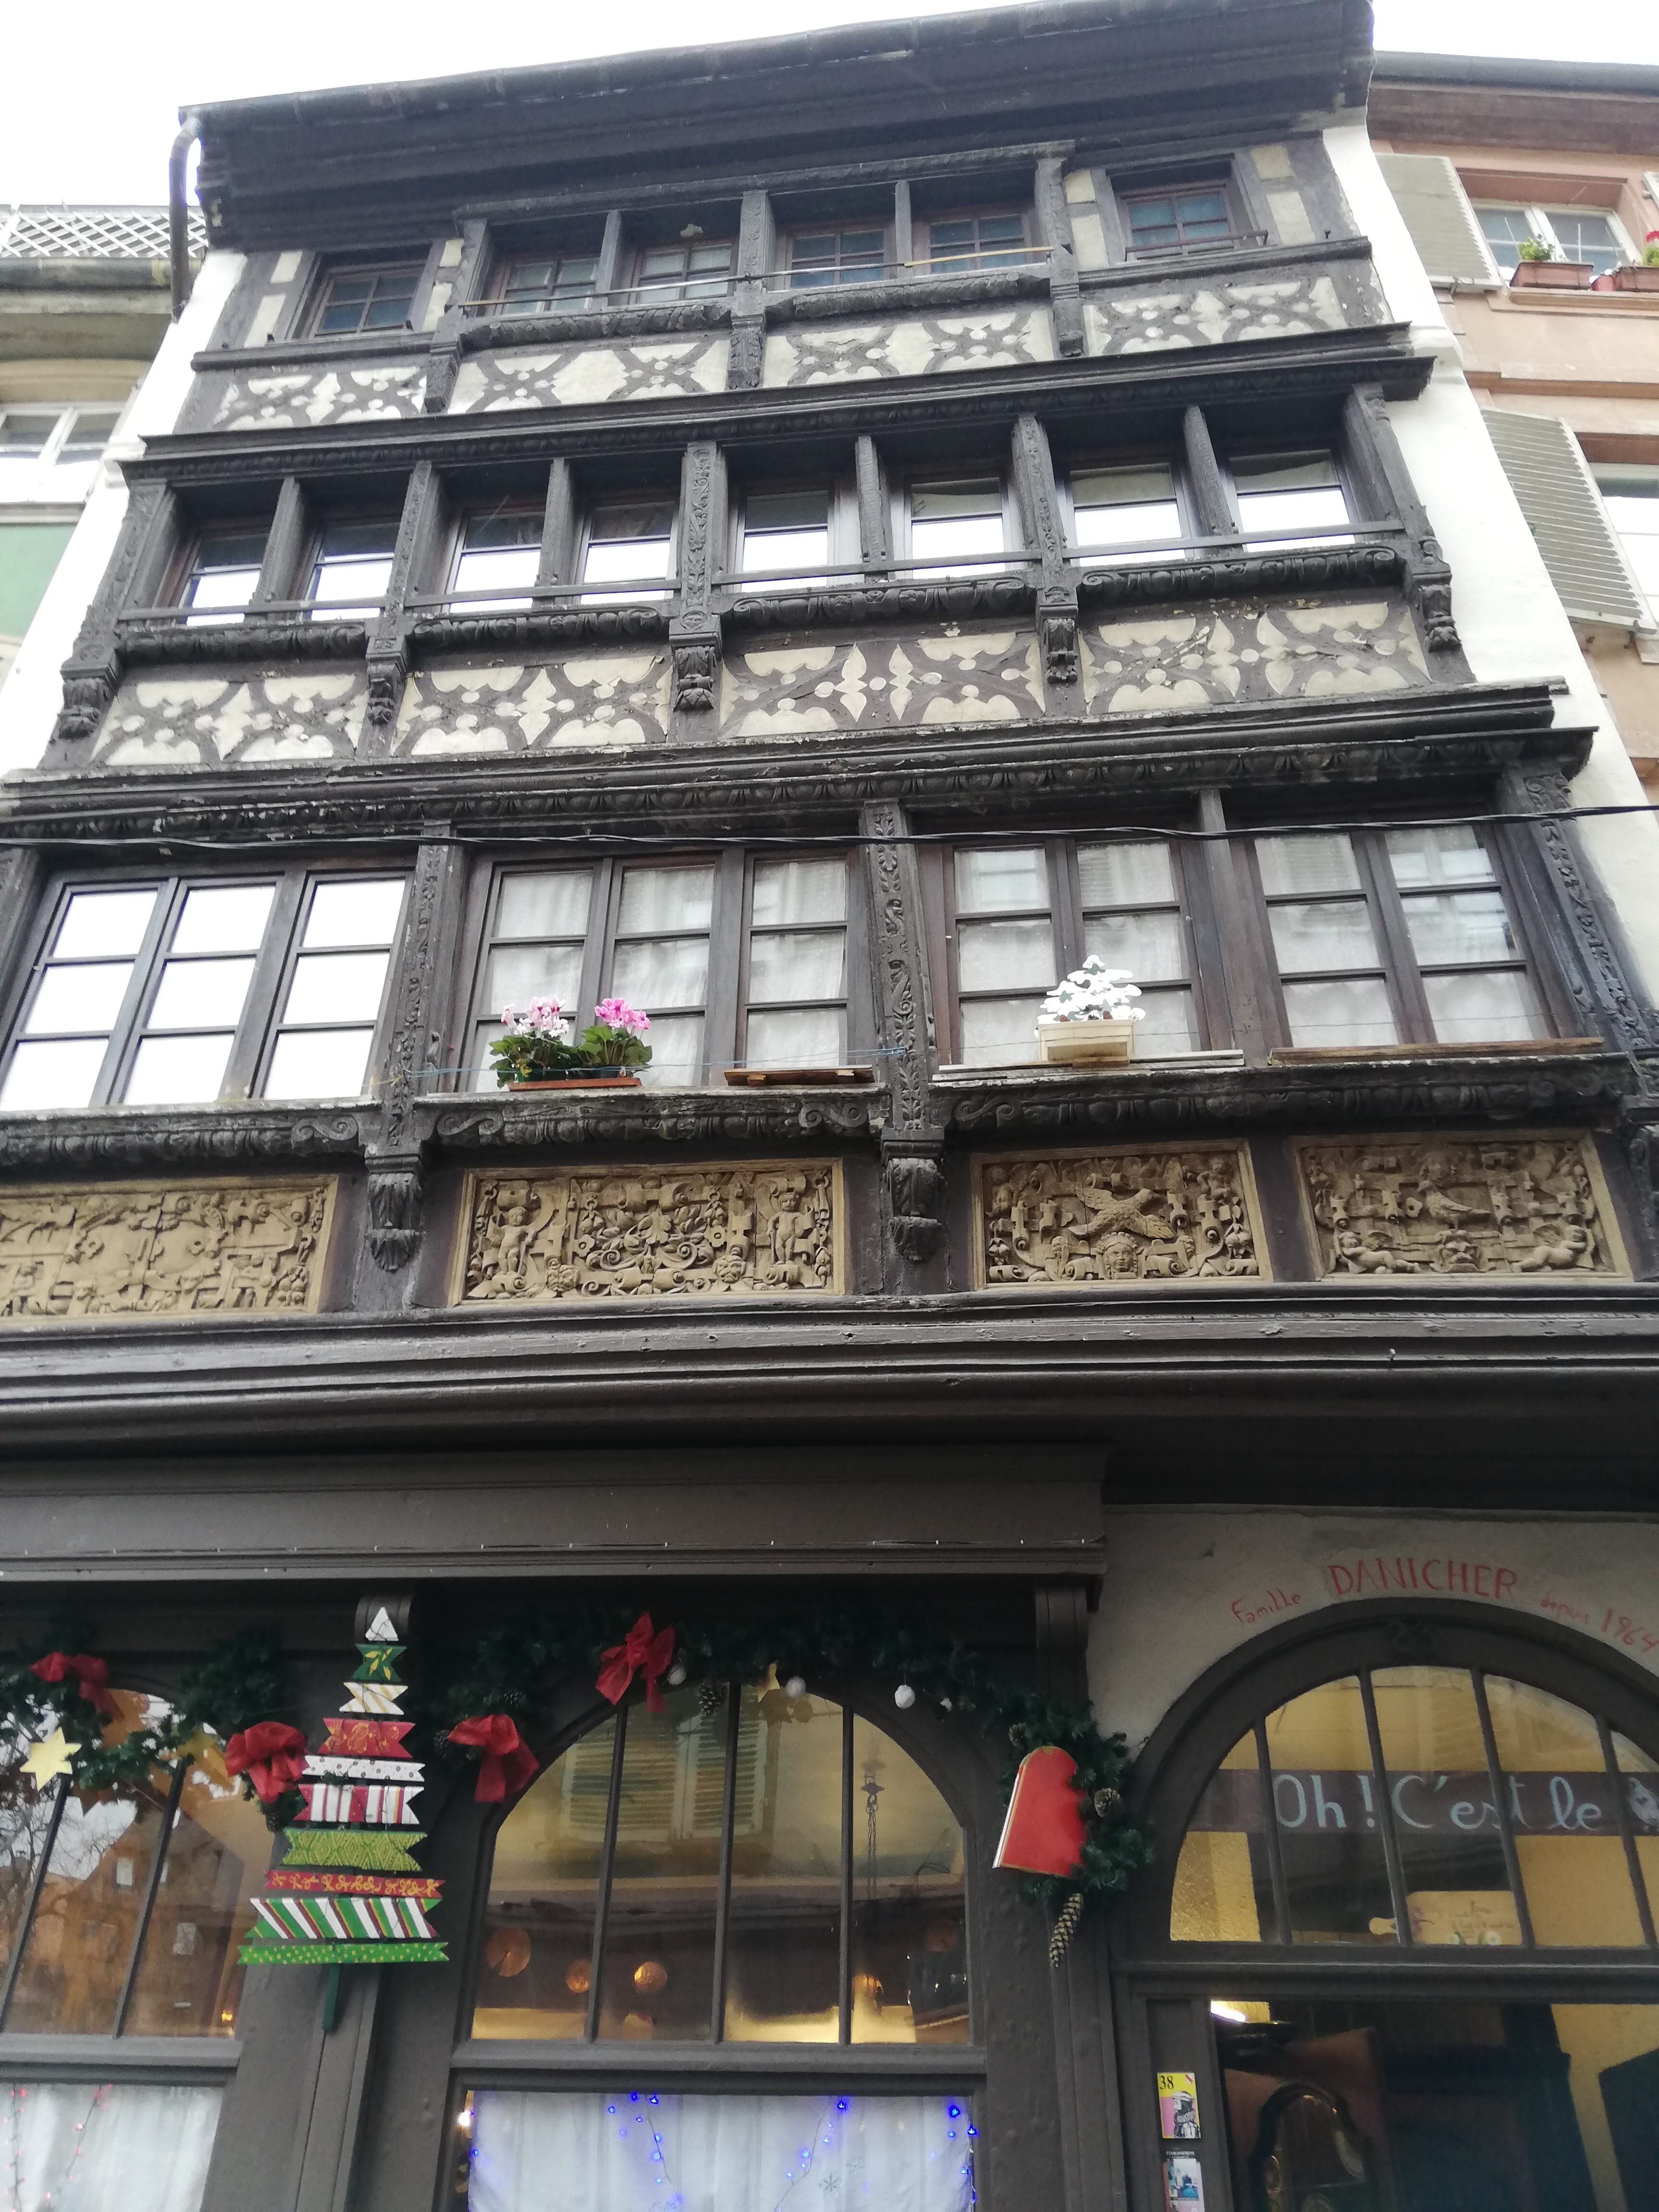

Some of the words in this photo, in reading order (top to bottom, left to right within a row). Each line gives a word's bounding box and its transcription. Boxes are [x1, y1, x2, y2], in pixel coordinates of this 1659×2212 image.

[1231, 1587, 1301, 1627] Famille
[1328, 1557, 1517, 1599] DANICHER
[1391, 1775, 1532, 1830] C'est
[1545, 1776, 1603, 1831] le
[1159, 2075, 1174, 2090] 38
